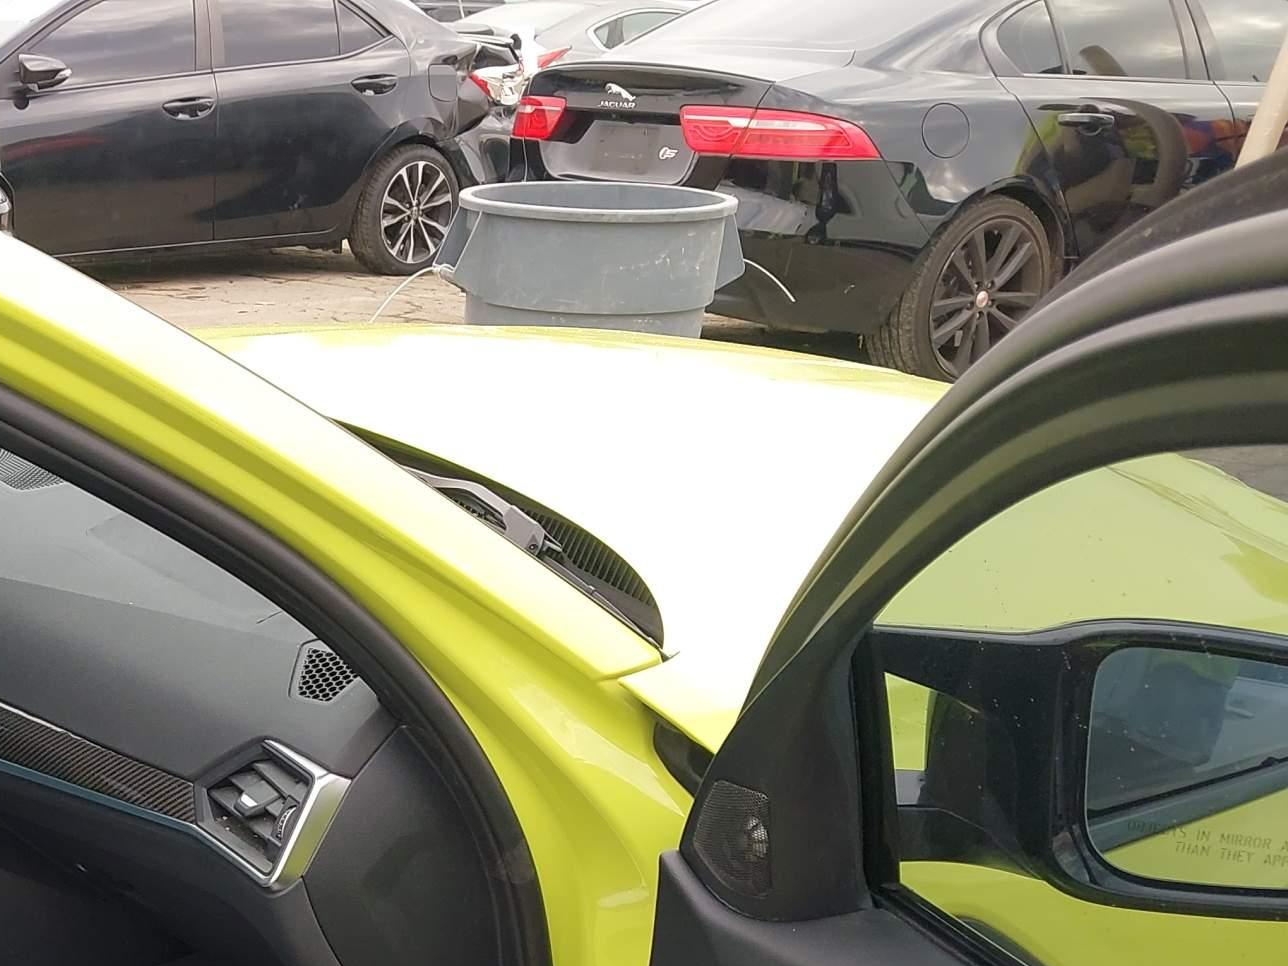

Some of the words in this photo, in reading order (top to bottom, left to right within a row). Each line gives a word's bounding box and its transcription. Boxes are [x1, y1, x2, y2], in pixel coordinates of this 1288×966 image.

[597, 100, 636, 109] JAGUAR
[1196, 828, 1211, 842] IN
[1219, 832, 1273, 850] MIRROR
[1175, 841, 1211, 857] THAN
[1219, 847, 1255, 863] THEY
